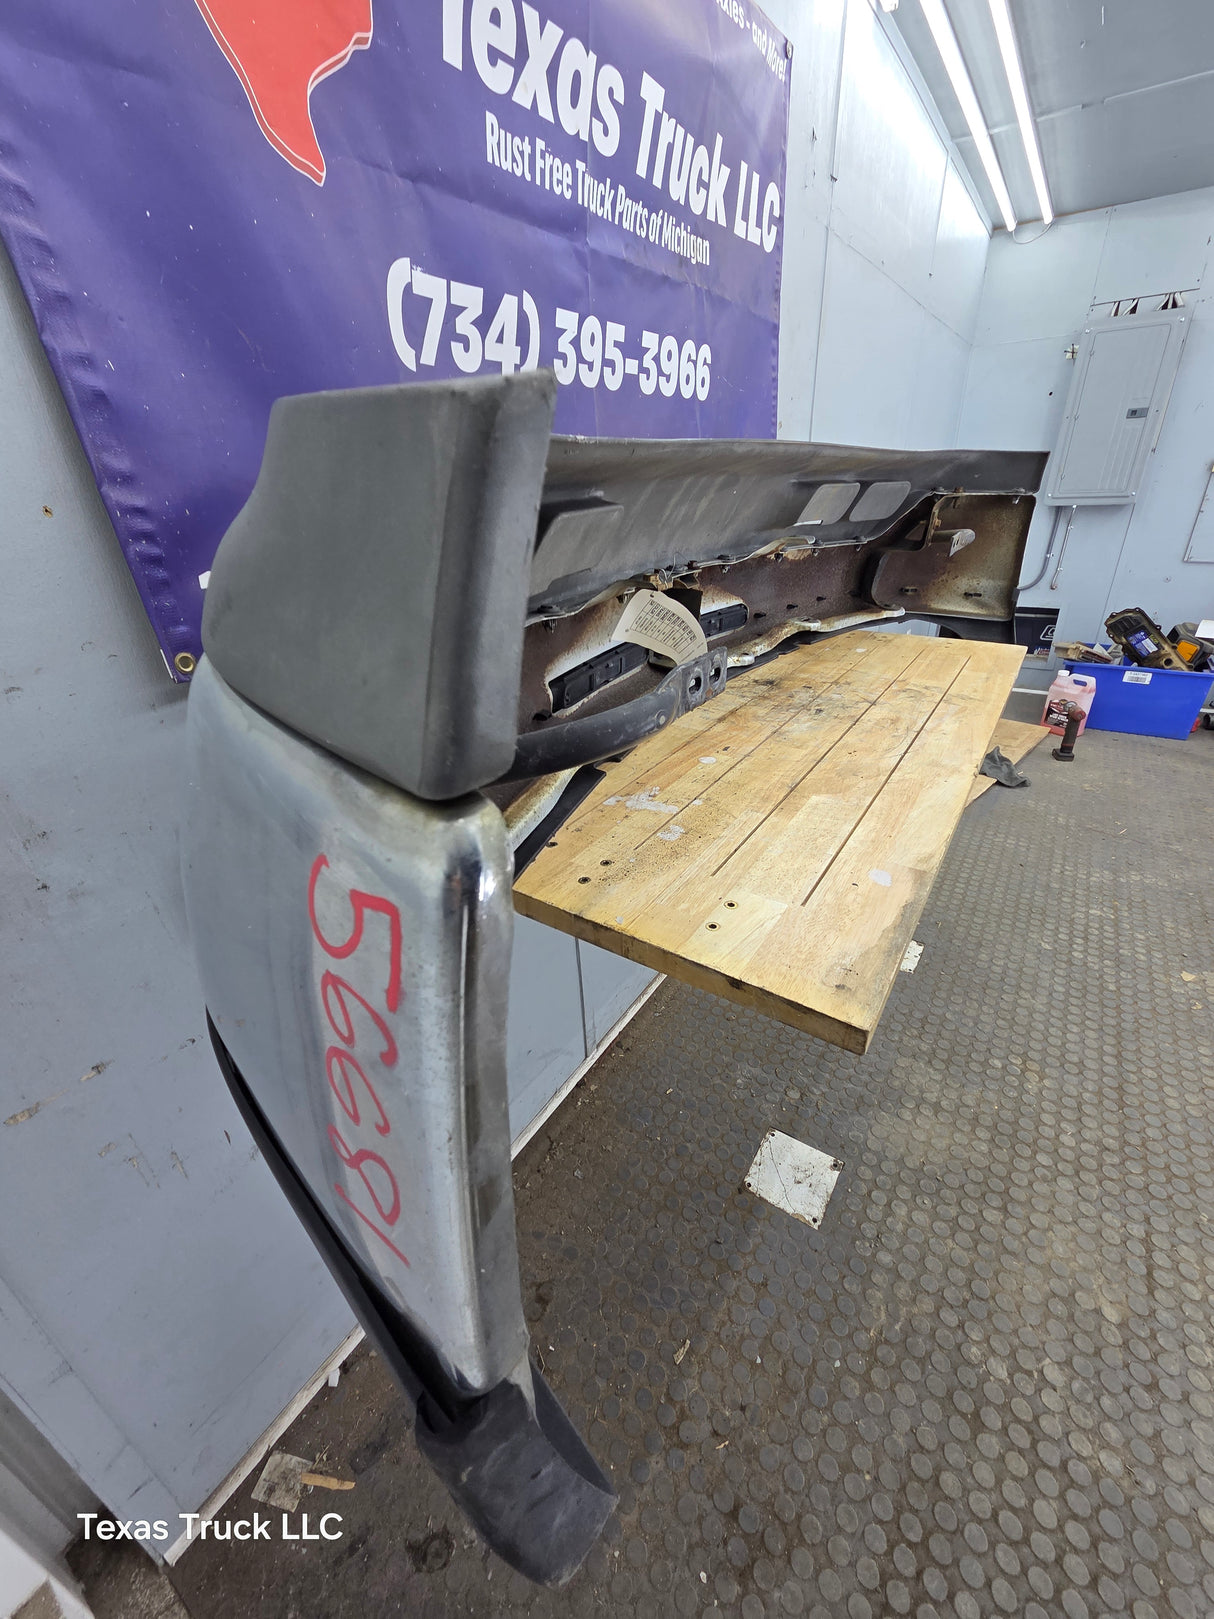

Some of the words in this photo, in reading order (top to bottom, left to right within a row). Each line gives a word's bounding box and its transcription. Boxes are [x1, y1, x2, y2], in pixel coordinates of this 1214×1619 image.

[751, 21, 768, 57] and
[766, 36, 788, 83] More!
[486, 110, 531, 181] Rust
[535, 137, 572, 200] Free
[576, 159, 615, 222] Truck
[615, 183, 647, 239] Parts
[648, 211, 663, 246] of
[661, 219, 710, 266] Michigan
[636, 71, 732, 229] Truck
[733, 160, 781, 253] LLC
[386, 257, 541, 376] (734)
[553, 307, 713, 401] 395-3966
